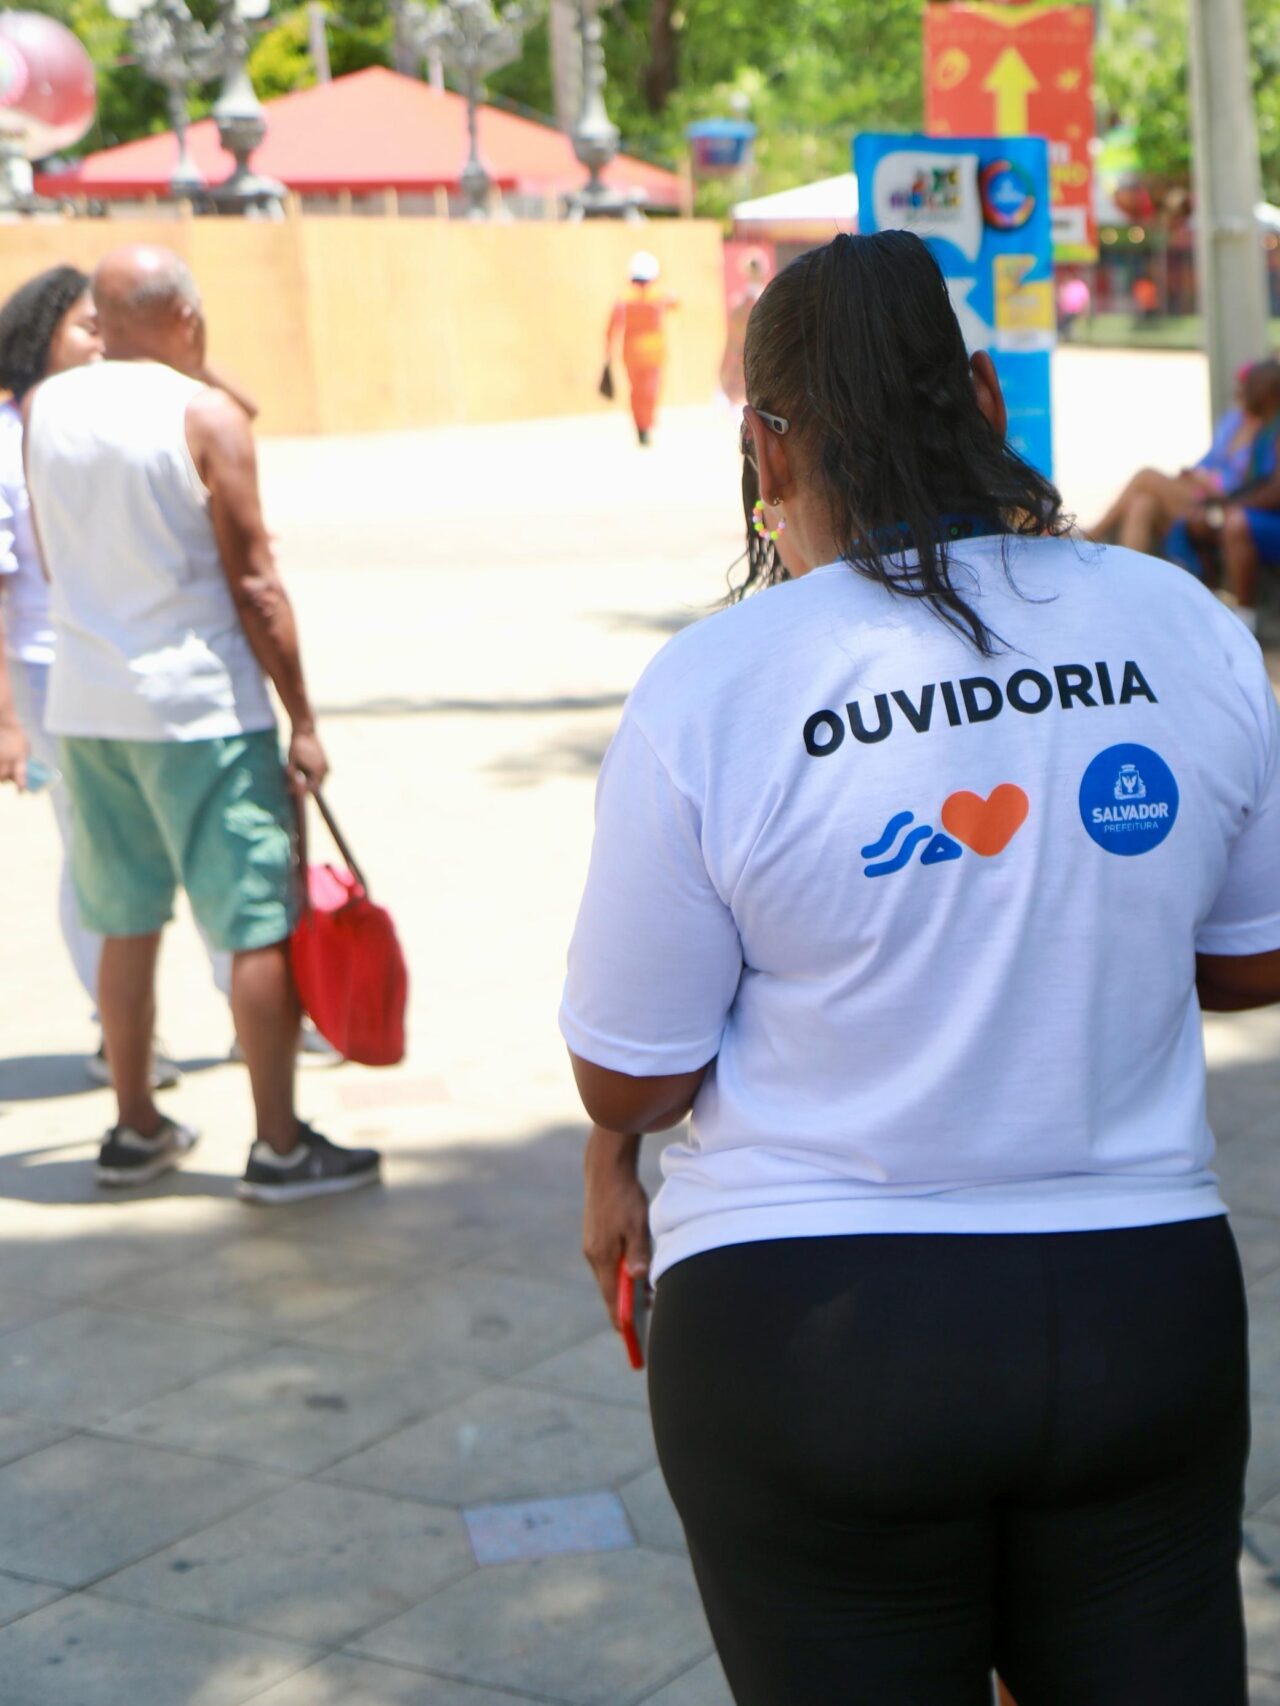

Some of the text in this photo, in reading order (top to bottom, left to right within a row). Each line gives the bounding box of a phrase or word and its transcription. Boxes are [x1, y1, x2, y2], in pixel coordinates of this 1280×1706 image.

[802, 660, 1159, 758] OUVIDORIA
[1092, 802, 1169, 824] SALVADOR
[1104, 821, 1159, 833] PREFEITURA
